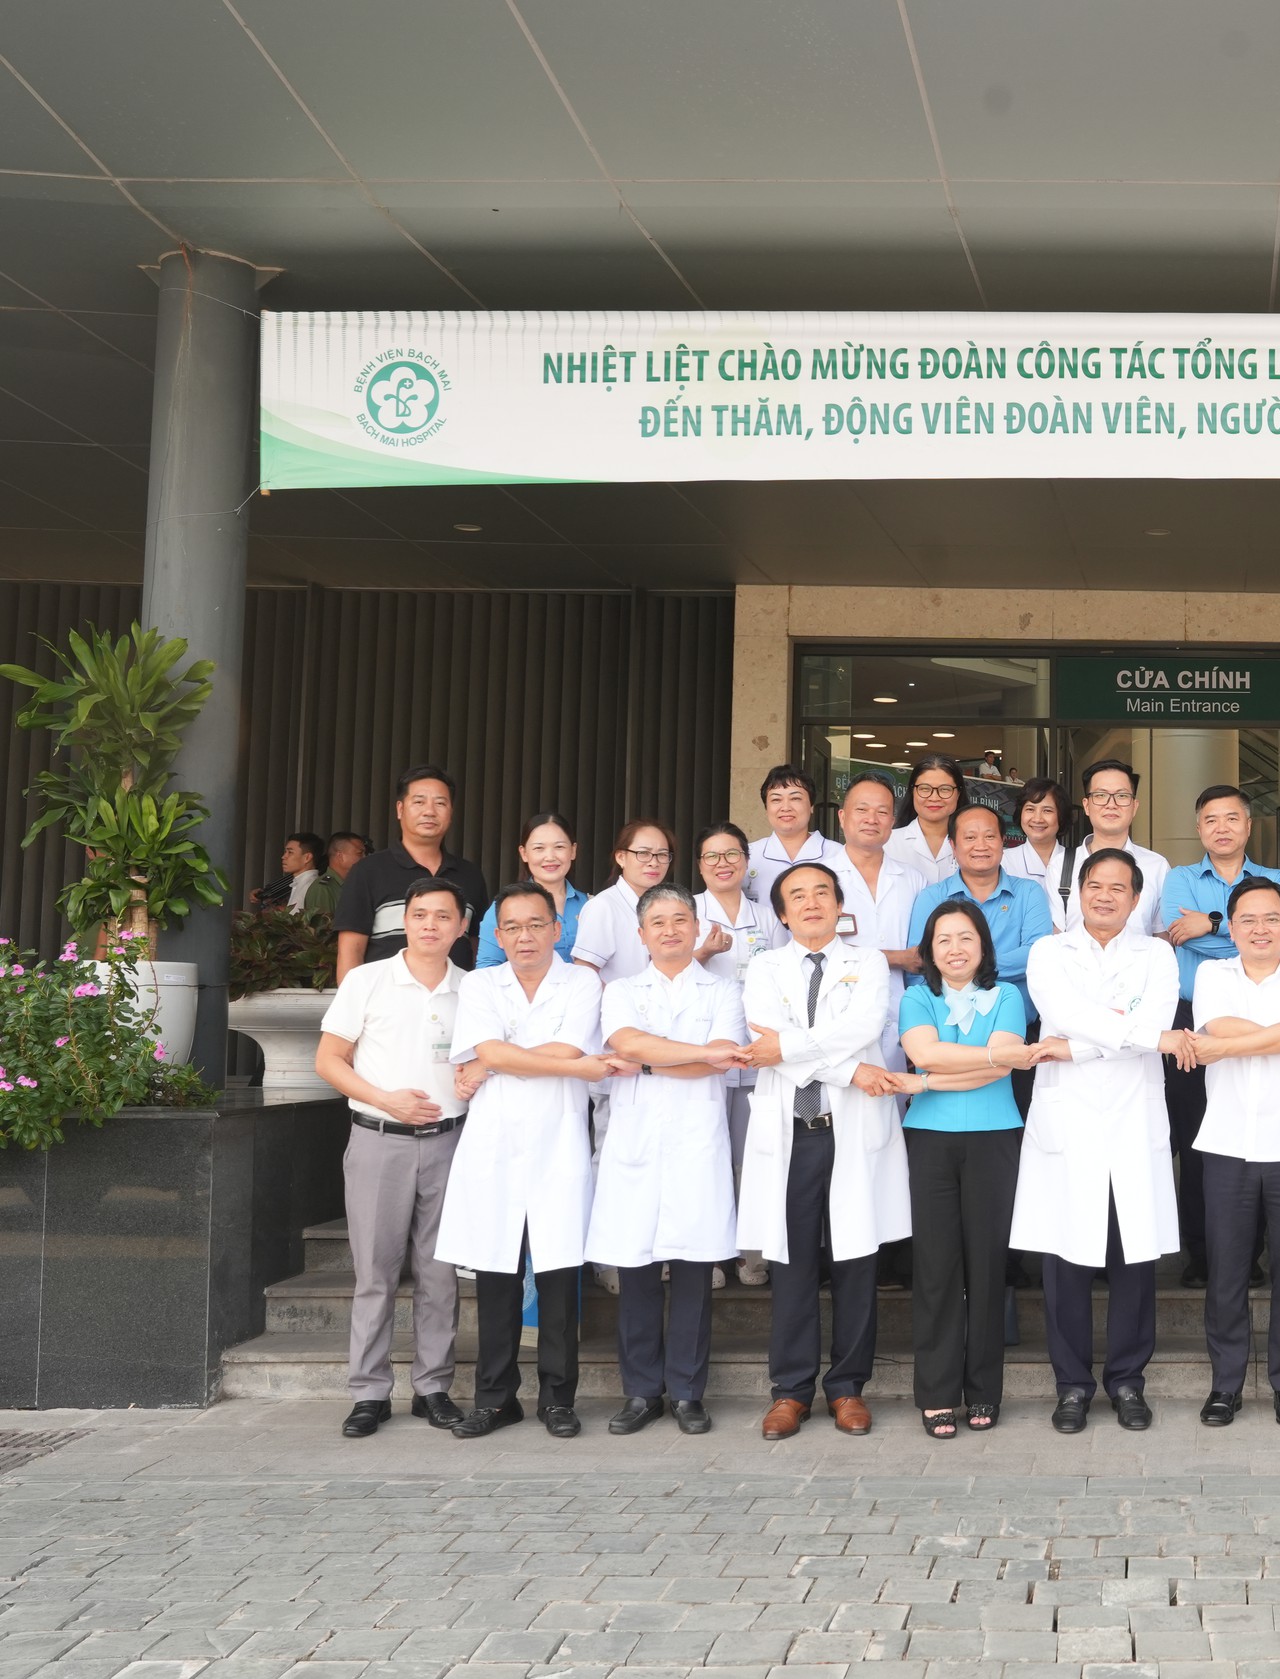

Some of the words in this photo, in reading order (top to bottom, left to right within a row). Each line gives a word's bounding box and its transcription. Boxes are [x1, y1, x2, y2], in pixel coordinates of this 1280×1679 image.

[353, 361, 376, 393] BỆNH
[375, 347, 404, 364] VIỆN
[407, 348, 440, 371] BẠCH
[437, 369, 452, 391] MAI
[543, 345, 637, 393] NHIỆT
[646, 344, 711, 390] LIỆT
[717, 342, 802, 382] CHÀO
[811, 341, 910, 381] MỪNG
[918, 341, 1007, 380] ĐOÀN
[1016, 342, 1102, 381] CÔNG
[1108, 342, 1166, 380] TÁC
[1172, 338, 1258, 380] TỔNG
[379, 434, 399, 447] MAI
[401, 417, 447, 447] HOSPITAL
[639, 394, 702, 438] ĐẾN
[711, 397, 814, 440] THĂM,
[822, 396, 913, 444] ĐỘNG
[922, 395, 994, 436] VIÊN
[1004, 395, 1092, 435] ĐOÀN
[1102, 395, 1186, 440] VIÊN,
[1116, 666, 1170, 689] CỬA
[1177, 666, 1251, 689] CHÍNH
[1126, 698, 1164, 712] Main
[1170, 698, 1240, 713] Entrance
